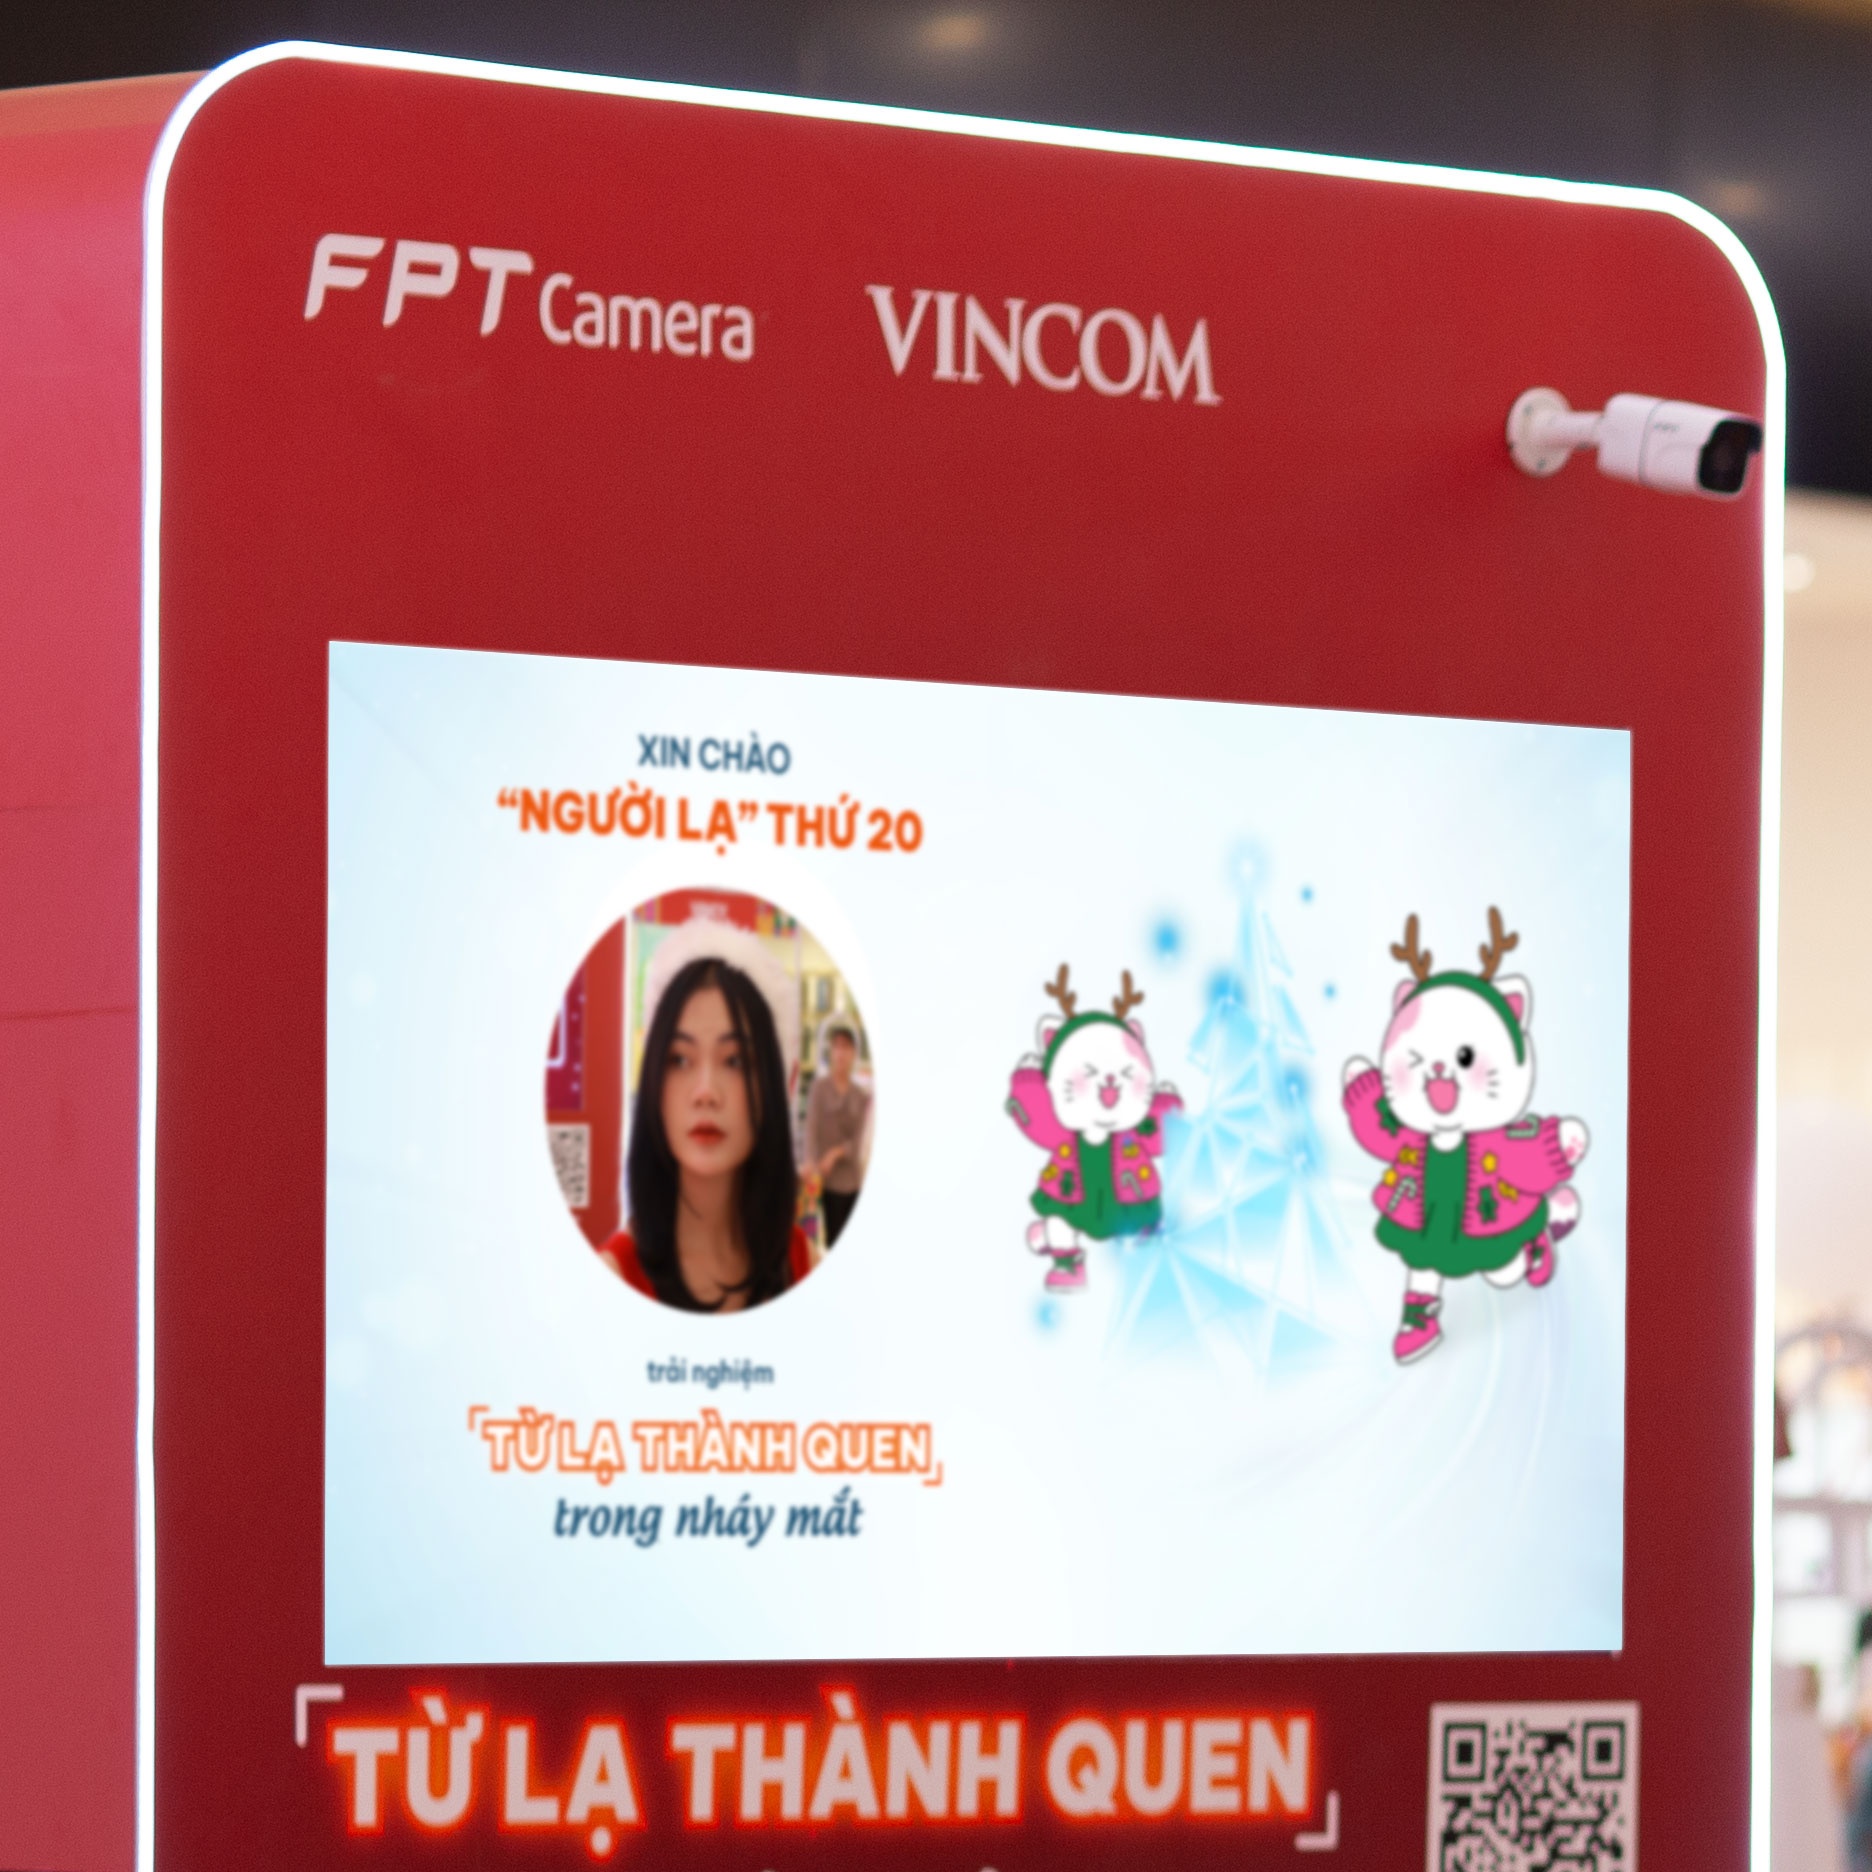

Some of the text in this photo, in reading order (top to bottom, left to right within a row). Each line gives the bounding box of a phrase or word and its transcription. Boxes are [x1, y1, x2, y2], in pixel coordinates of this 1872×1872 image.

[304, 233, 755, 363] FPT Camera
[865, 284, 1224, 407] VINCOM
[636, 731, 792, 776] XIN CHÀO
[766, 793, 861, 849] THỨ
[866, 808, 924, 854] 20
[646, 1356, 776, 1391] trải nghiệm
[481, 1405, 933, 1486] TỪ LẠ THÀNH QUEN
[552, 1484, 864, 1549] trong nháy mắt
[330, 1688, 1313, 1858] TỪ LẠ THÀNH QUEN
